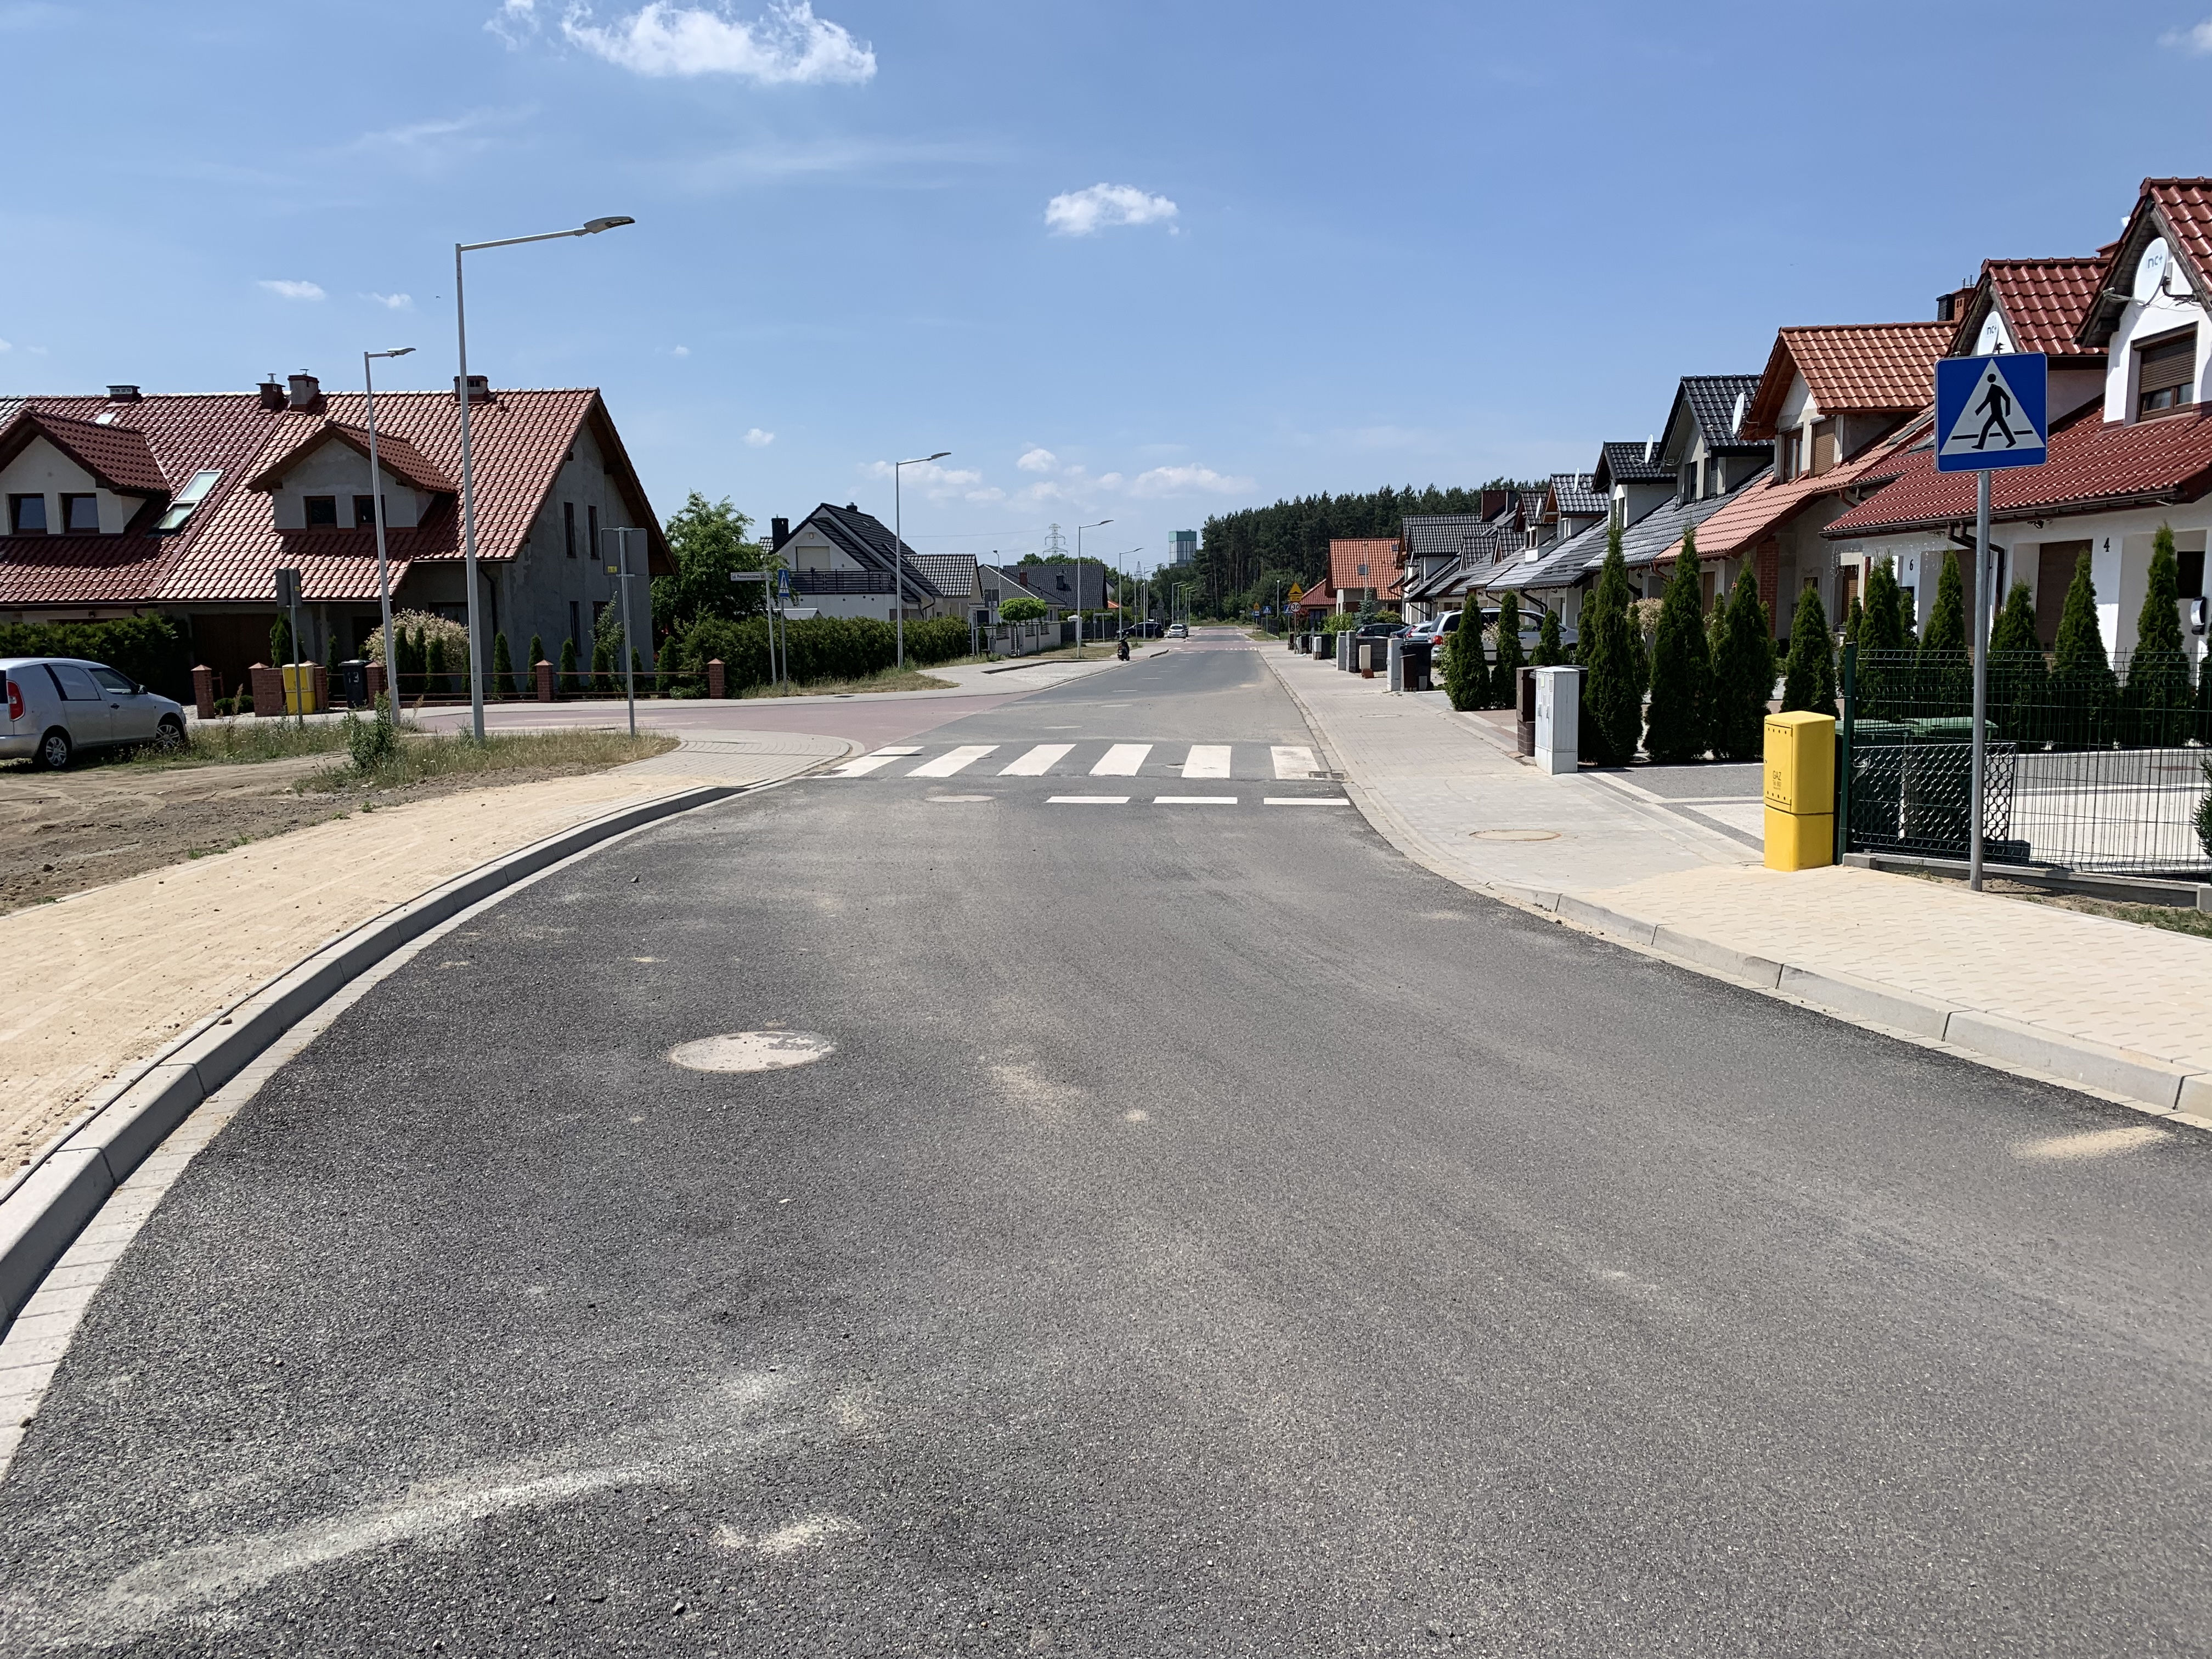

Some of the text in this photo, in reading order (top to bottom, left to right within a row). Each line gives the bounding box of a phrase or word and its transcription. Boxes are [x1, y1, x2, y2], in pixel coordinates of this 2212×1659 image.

[2148, 253, 2163, 269] nc+
[2103, 537, 2110, 552] 4
[1910, 558, 1914, 571] 6
[1773, 770, 1781, 781] GAZ
